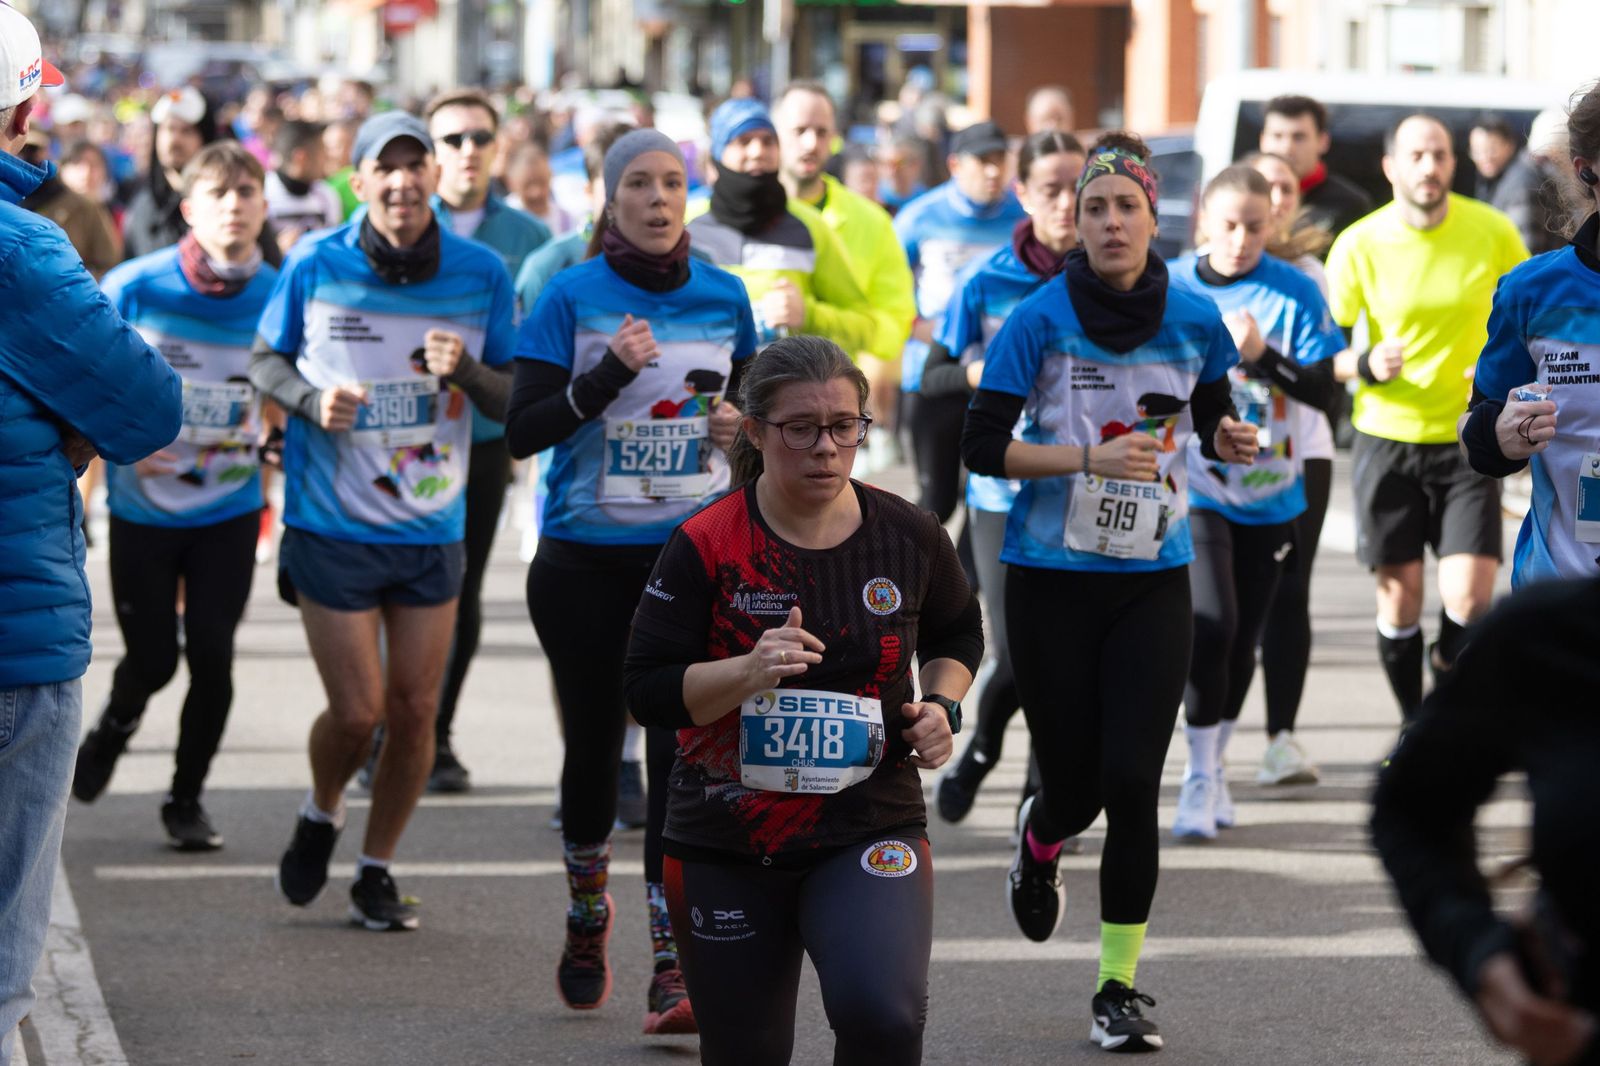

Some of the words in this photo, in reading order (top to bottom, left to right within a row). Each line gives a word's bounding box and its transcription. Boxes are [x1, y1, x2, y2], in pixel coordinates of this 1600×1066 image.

[1560, 352, 1579, 361] SAN
[1547, 363, 1590, 373] SILVESTRE
[365, 397, 418, 427] 3190
[636, 424, 700, 438] SETEL
[620, 441, 688, 472] 5297
[1105, 481, 1162, 500] SETEL
[1096, 498, 1138, 531] 519
[752, 592, 798, 601] Mesonero
[752, 601, 783, 610] Molina
[779, 696, 869, 718] SETEL
[764, 717, 845, 760] 3418
[791, 758, 816, 768] CHUS
[801, 775, 840, 784] Ayuntamiento
